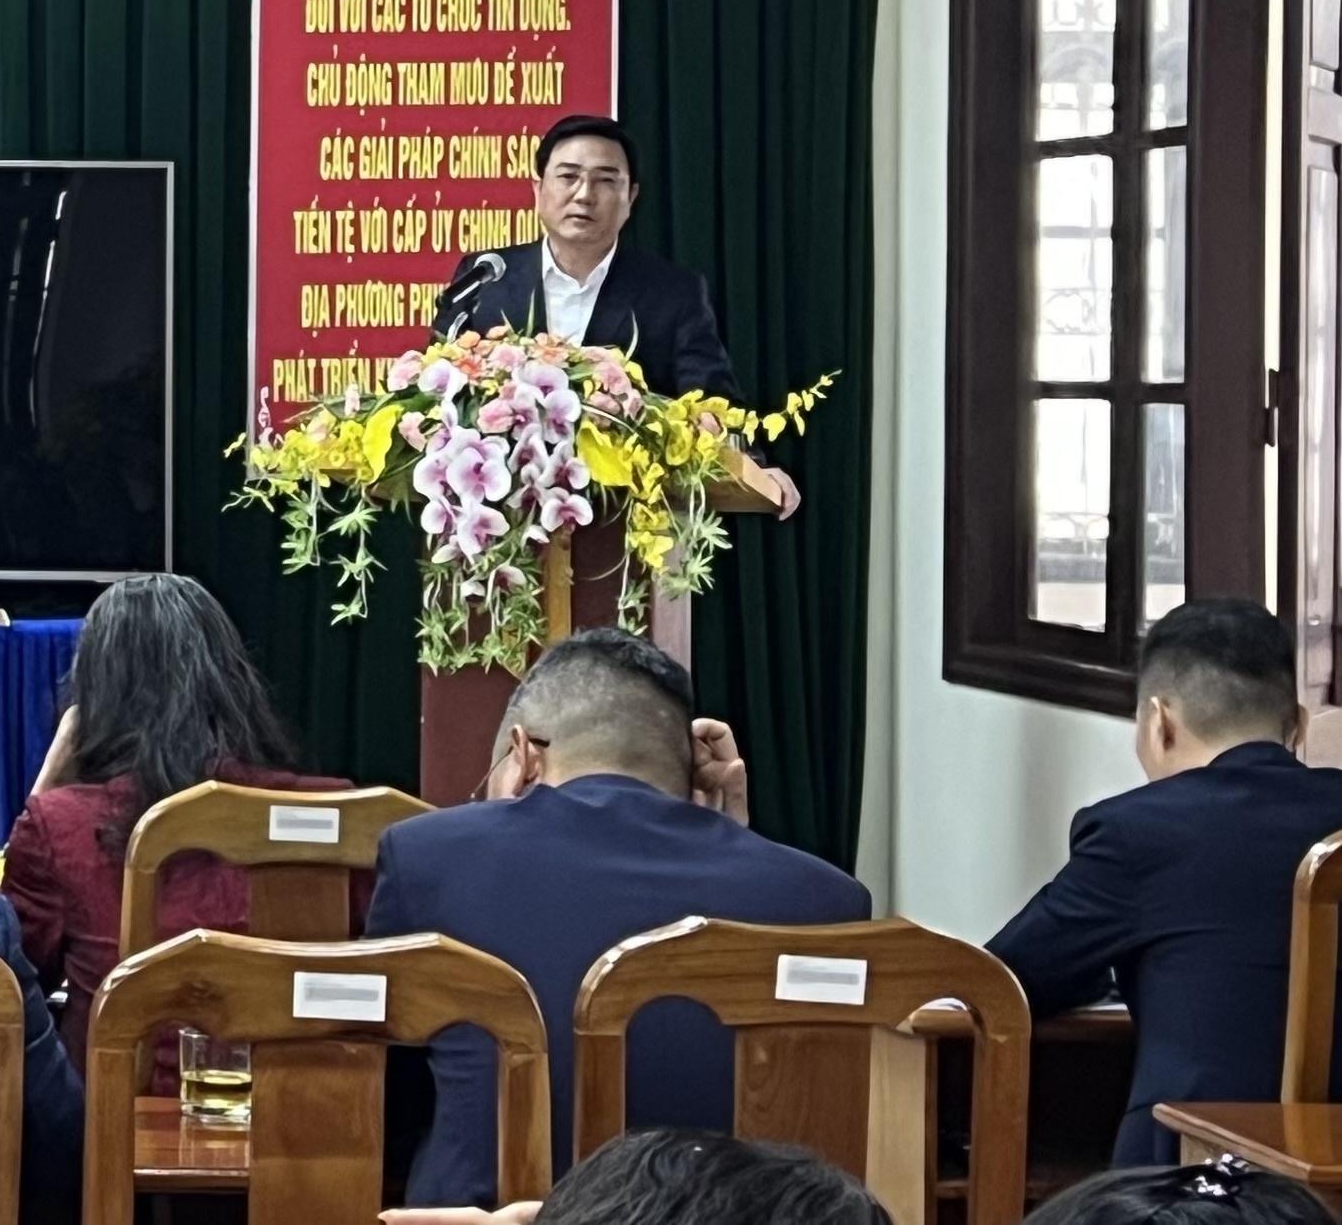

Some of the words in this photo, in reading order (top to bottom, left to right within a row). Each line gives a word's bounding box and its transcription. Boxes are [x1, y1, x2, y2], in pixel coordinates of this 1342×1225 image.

[307, 44, 341, 106] CHỦ
[345, 53, 392, 116] ĐỘNG
[397, 62, 445, 105] THAM
[520, 46, 564, 105] XUẤT
[320, 128, 355, 180] CÁC
[359, 118, 393, 179] GIẢI
[398, 126, 444, 179] PHÁP
[449, 126, 502, 179] CHÍNH
[507, 126, 542, 180] SÁC
[336, 201, 355, 263] TỆ
[360, 196, 388, 254] VỚI
[392, 194, 427, 253] CẤP
[458, 200, 511, 254] CHÍNH
[301, 284, 330, 338] ĐỊA
[335, 280, 404, 327] PHƯƠNG
